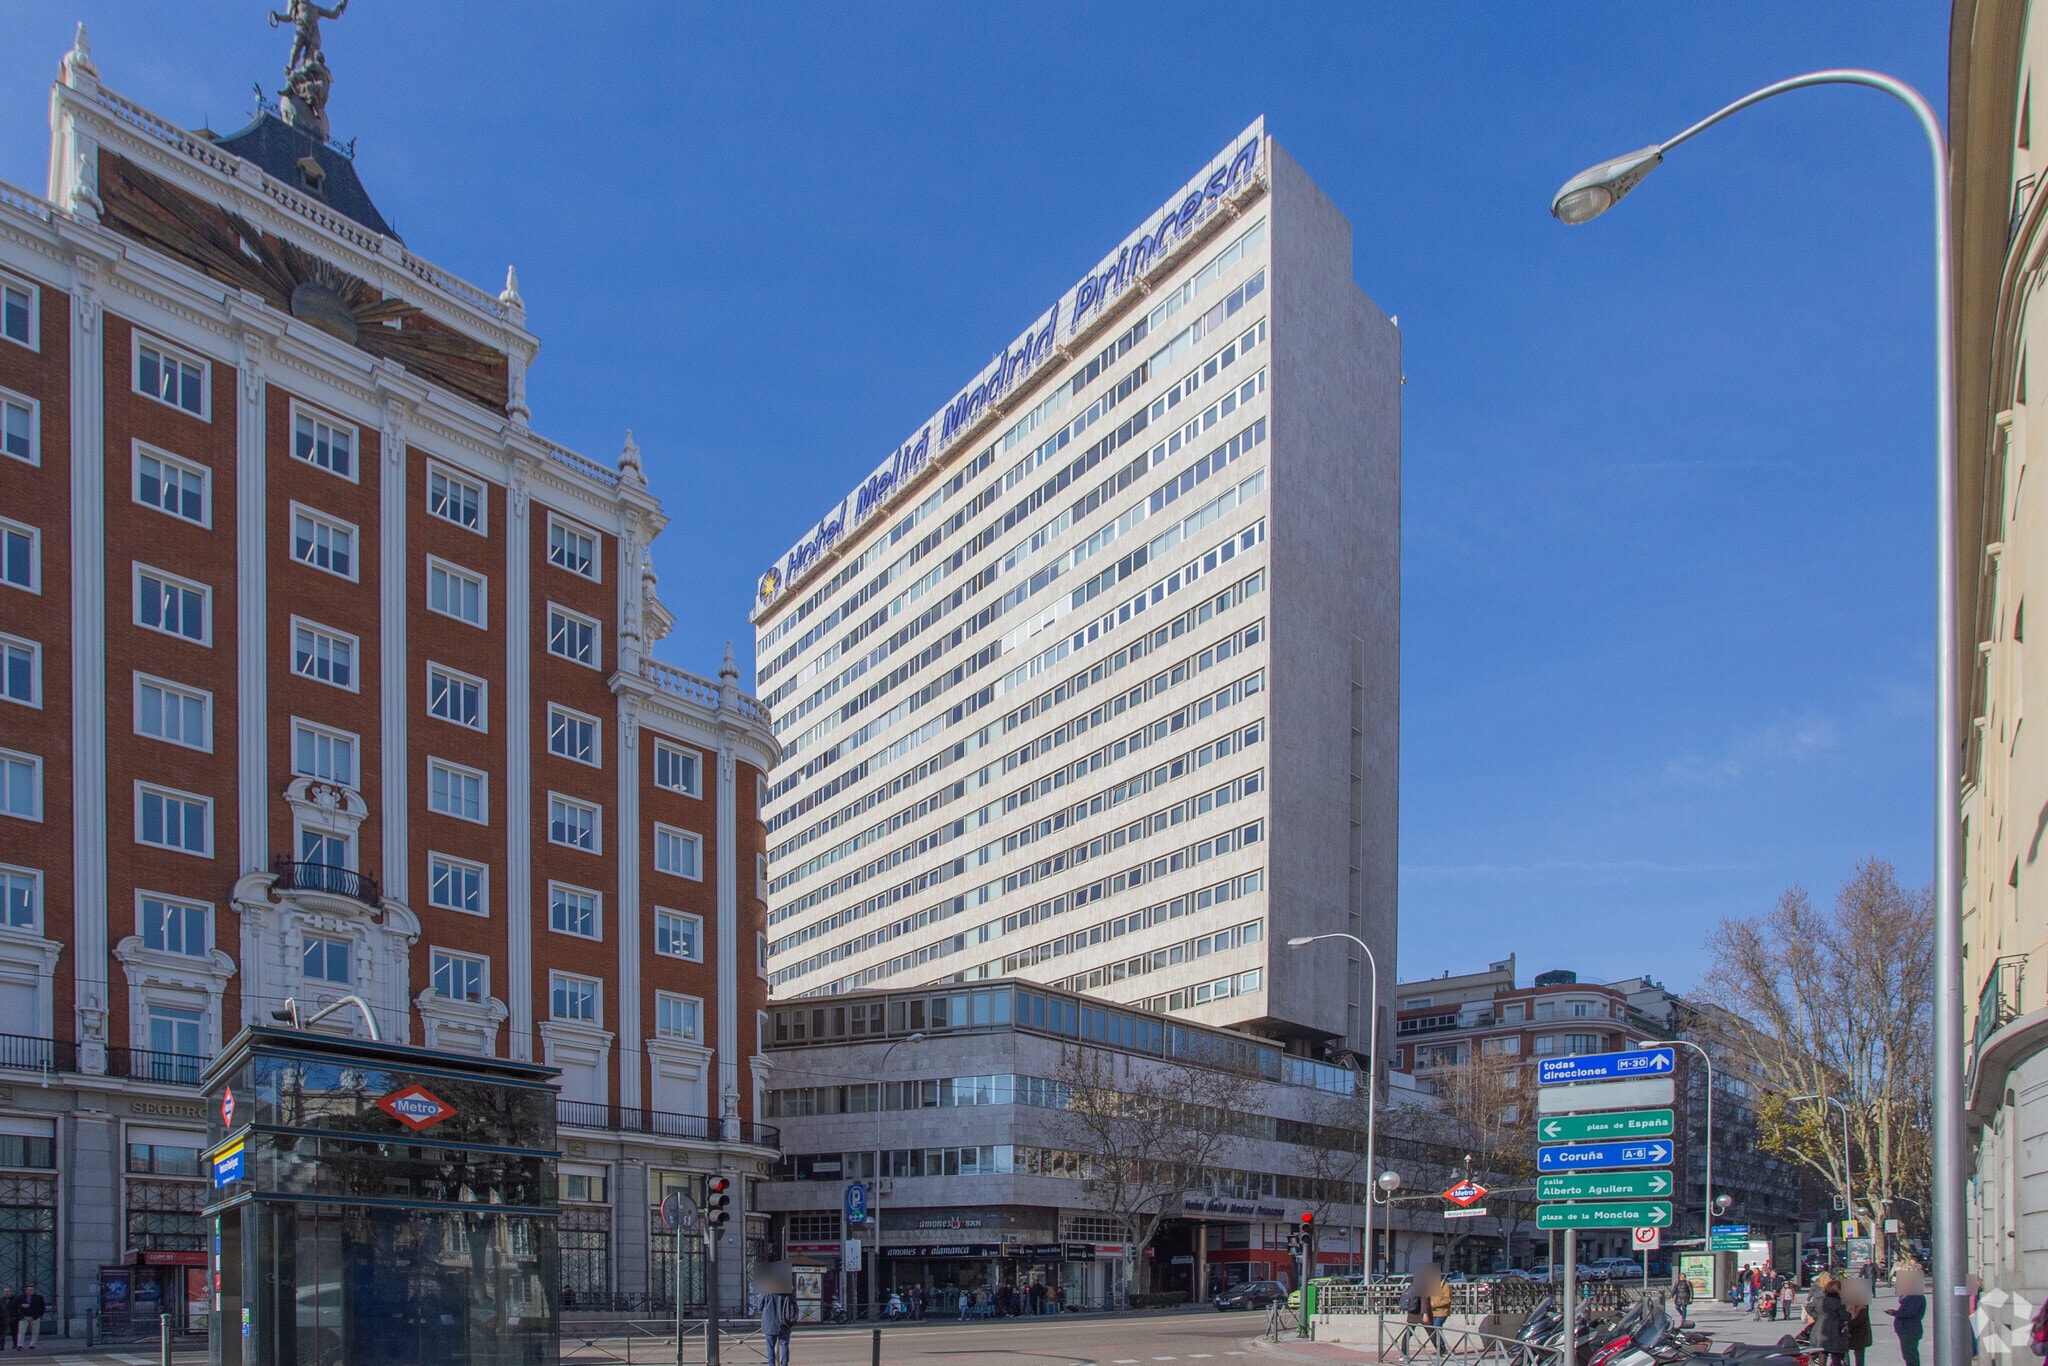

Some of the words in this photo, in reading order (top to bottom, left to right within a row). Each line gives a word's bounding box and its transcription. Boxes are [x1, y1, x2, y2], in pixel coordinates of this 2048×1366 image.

[786, 498, 848, 586] Hotel
[940, 301, 1060, 449] Madrid
[1070, 136, 1258, 334] Princesa
[1543, 1061, 1575, 1070] todas
[1619, 1059, 1646, 1068] M-30
[1543, 1067, 1607, 1080] direcciones
[397, 1100, 436, 1114] Metro
[1586, 1124, 1609, 1132] plaza
[1628, 1118, 1669, 1129] España
[1542, 1153, 1552, 1163] A
[1559, 1151, 1604, 1162] Coruña
[1625, 1149, 1644, 1158] A-6
[1543, 1187, 1582, 1196] Alberto
[1588, 1185, 1633, 1195] Aguilera
[1541, 1214, 1563, 1222] plaza
[1594, 1210, 1639, 1219] Moncloa
[885, 1246, 916, 1256] amones
[929, 1245, 970, 1256] alamanca
